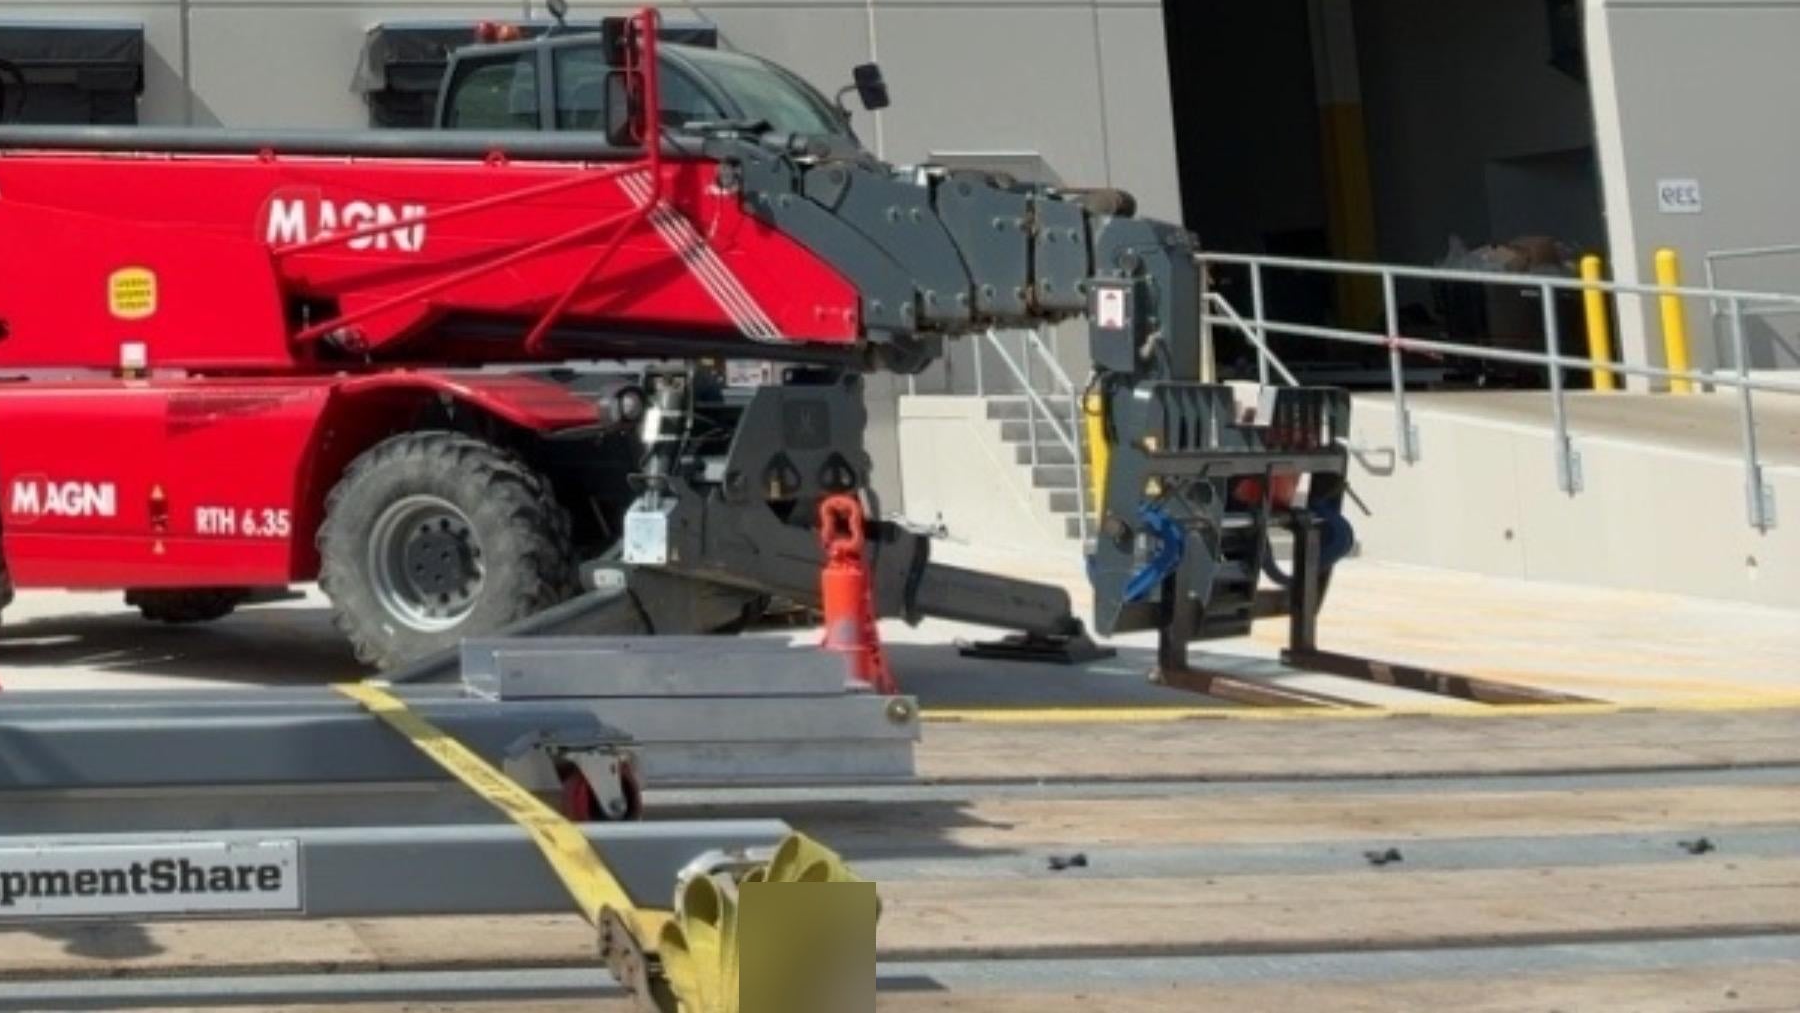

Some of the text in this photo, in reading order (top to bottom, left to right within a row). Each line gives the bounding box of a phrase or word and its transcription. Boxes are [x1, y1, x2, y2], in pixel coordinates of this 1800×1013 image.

[266, 199, 427, 252] MAGNI
[11, 481, 115, 516] MAGNI
[195, 506, 290, 536] RTH 6.35
